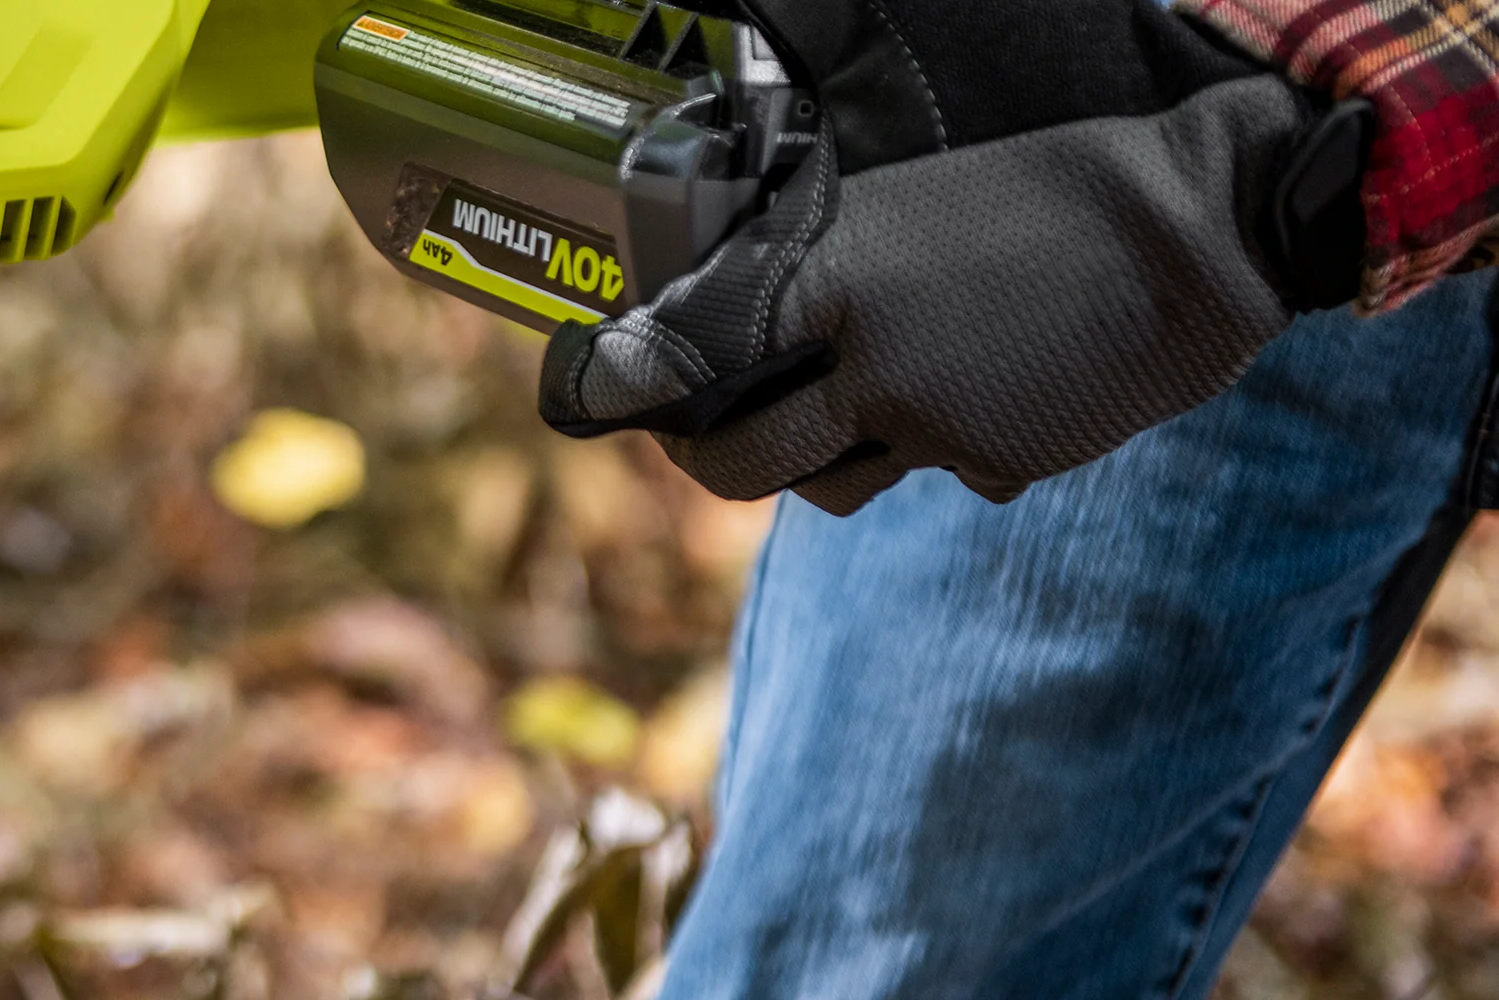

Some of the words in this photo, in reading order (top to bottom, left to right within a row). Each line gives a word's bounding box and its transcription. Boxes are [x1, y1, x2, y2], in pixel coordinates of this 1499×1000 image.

[777, 131, 818, 145] HIUM
[452, 198, 553, 263] LITHIUM
[422, 238, 453, 266] 4Ah
